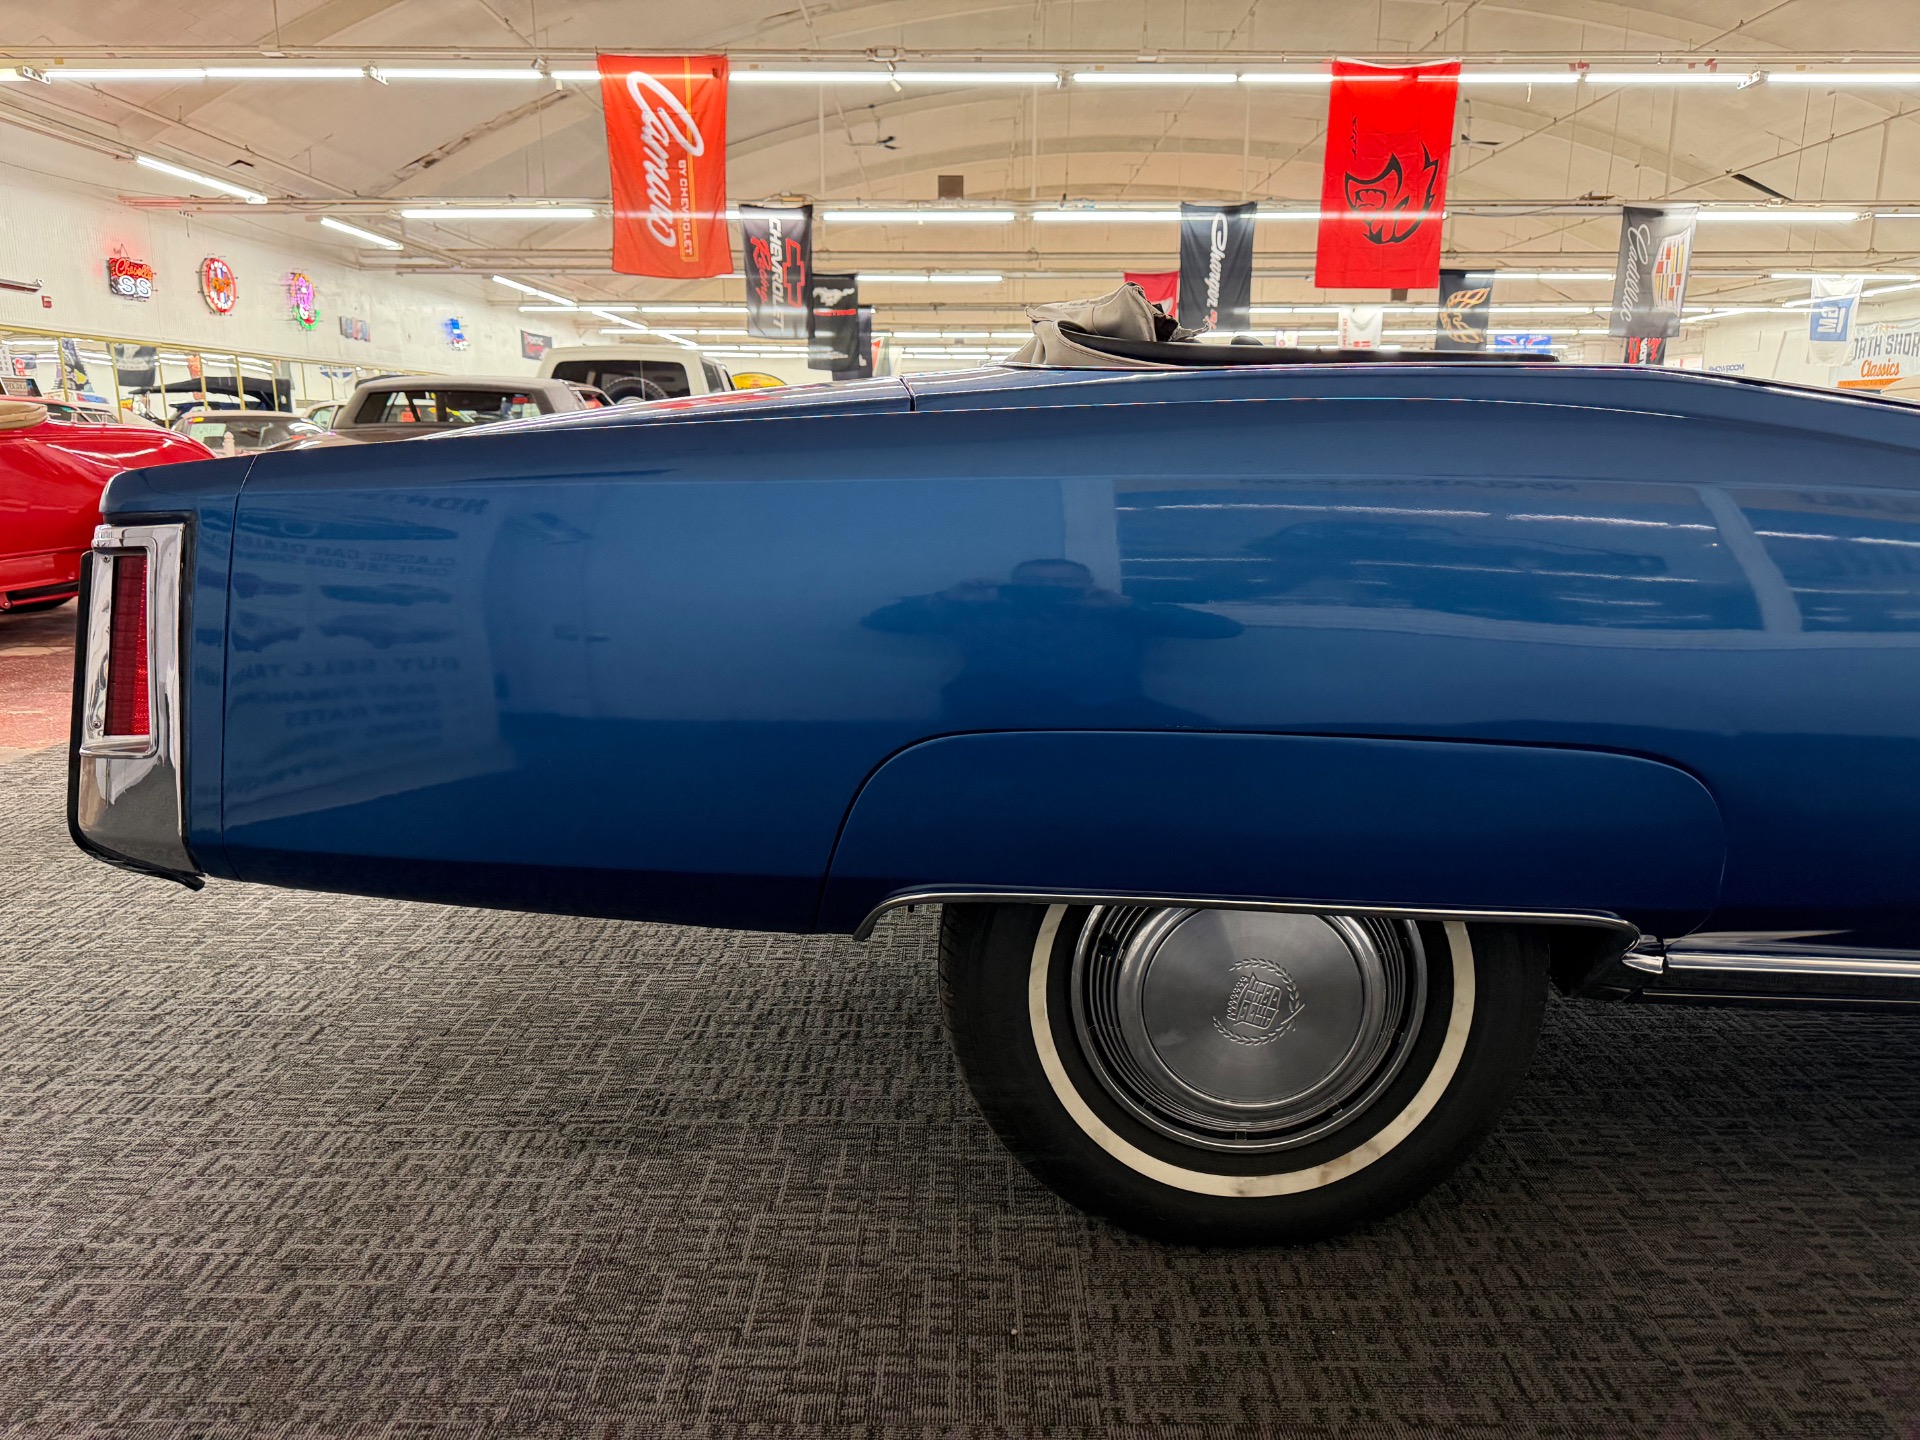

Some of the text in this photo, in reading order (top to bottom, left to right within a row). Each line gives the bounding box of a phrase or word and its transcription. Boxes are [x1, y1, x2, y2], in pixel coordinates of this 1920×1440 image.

[626, 71, 705, 248] Camaro
[678, 159, 693, 255] BY CHEVROLET
[119, 275, 152, 298] SS
[751, 236, 773, 303] Racing
[768, 217, 785, 332] CHEVROLET
[1204, 213, 1228, 308] Charger
[1620, 224, 1650, 322] Cadillac
[1861, 357, 1900, 378] Classics
[1885, 332, 1920, 357] SHOR
